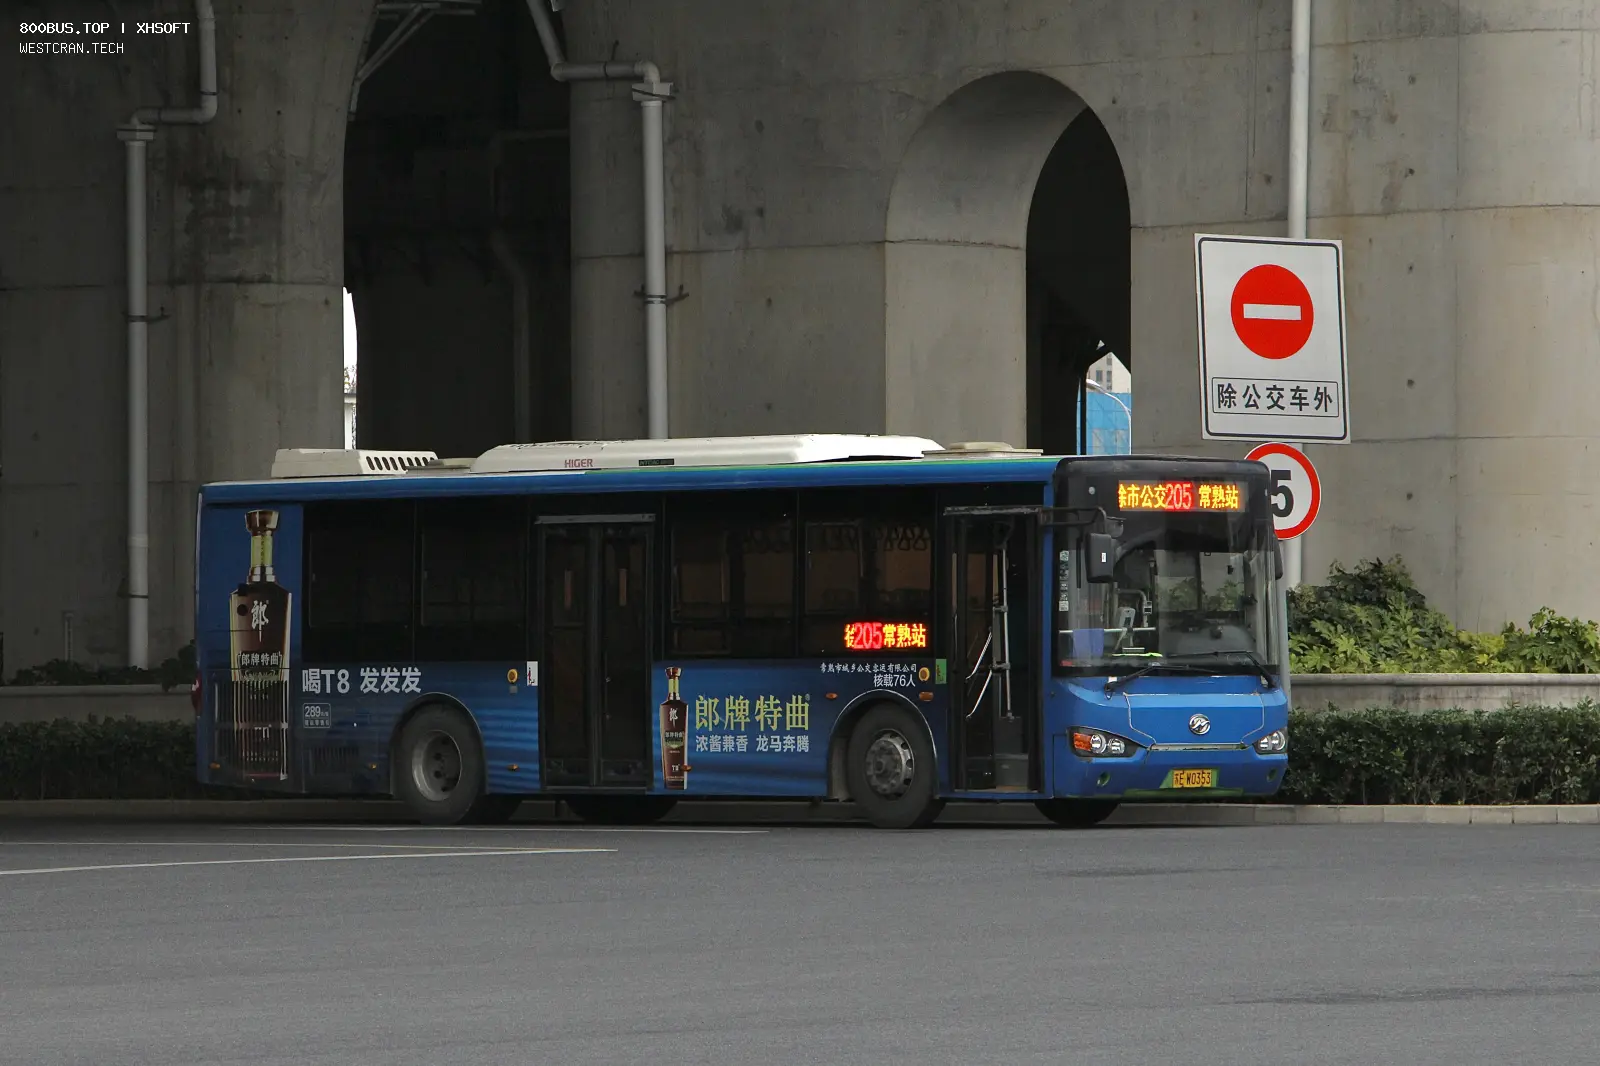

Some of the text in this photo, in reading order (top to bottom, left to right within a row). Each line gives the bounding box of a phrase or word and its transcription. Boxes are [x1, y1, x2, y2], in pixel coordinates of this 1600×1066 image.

[1217, 382, 1334, 413] 除公交车外
[564, 459, 594, 468] HIGER
[1198, 484, 1239, 509] 常熟站
[241, 652, 279, 666] 郎牌特曲
[302, 669, 350, 694] 喝T8
[360, 667, 422, 694] 发发发
[873, 674, 916, 687] 核载76人
[695, 735, 810, 752] 浓酱兼香 龙马奔腾
